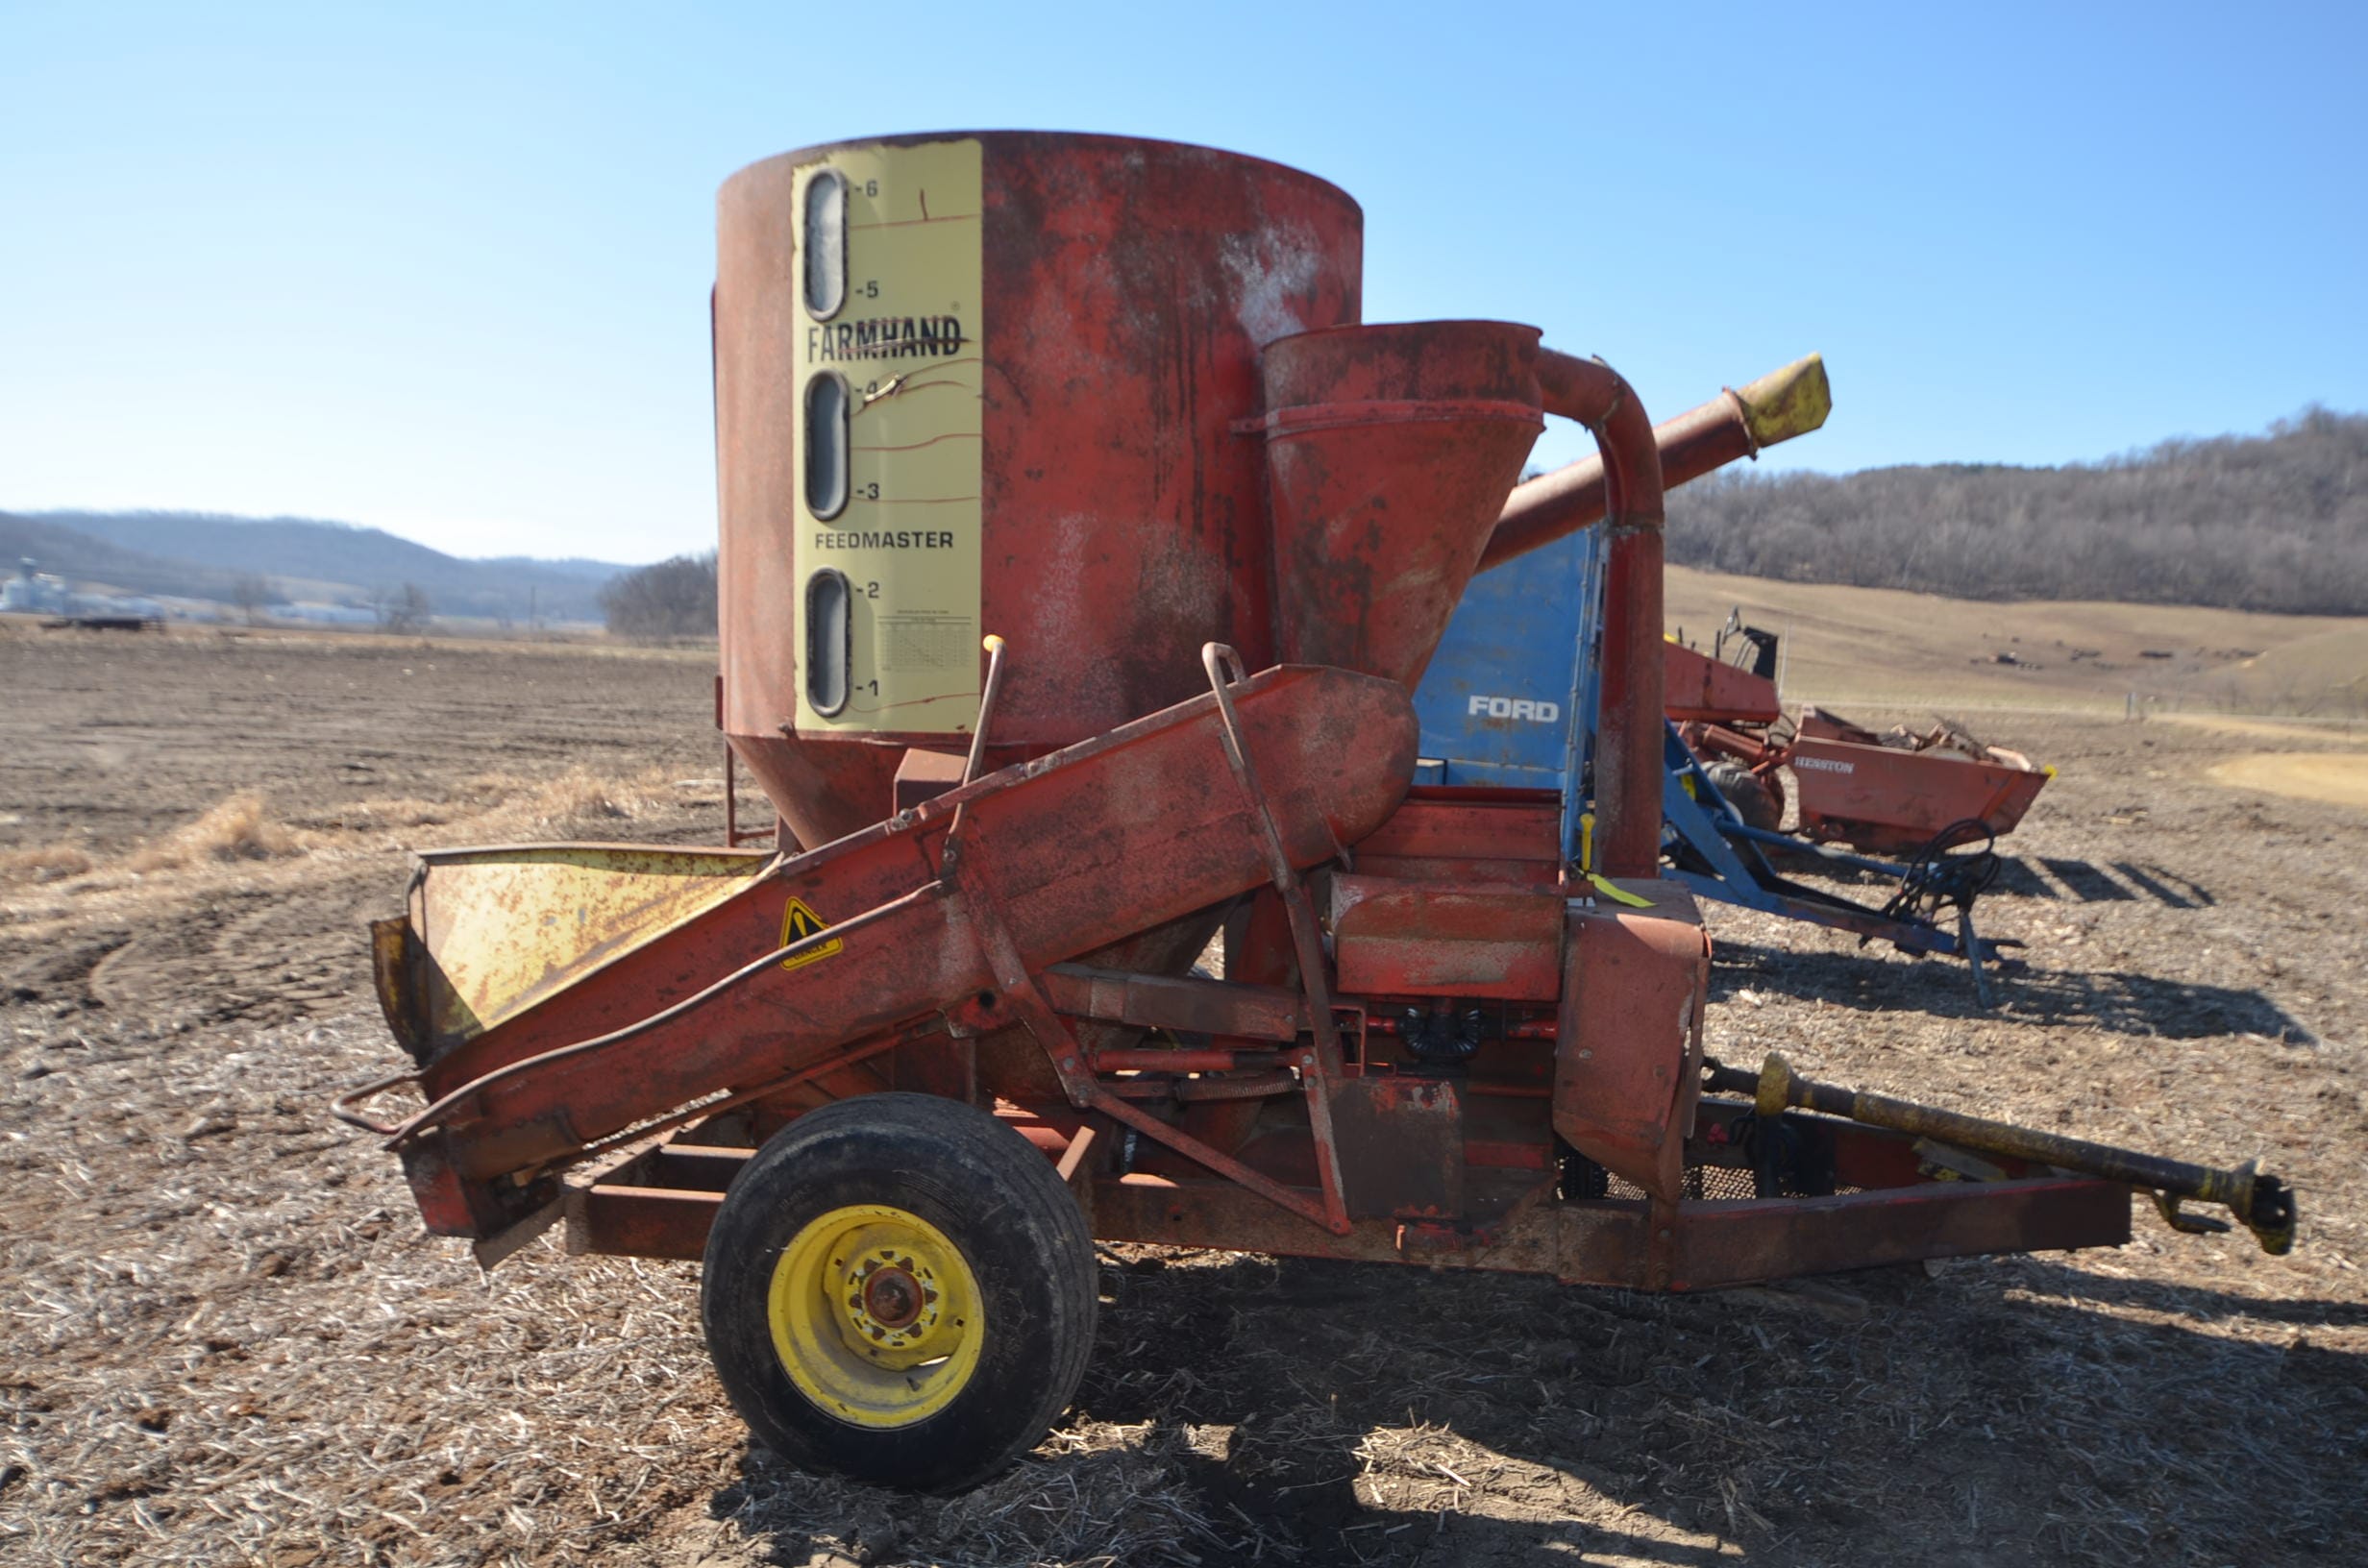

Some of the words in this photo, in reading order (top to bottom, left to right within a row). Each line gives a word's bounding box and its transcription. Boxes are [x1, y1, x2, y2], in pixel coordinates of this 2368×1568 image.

[807, 315, 961, 363] FARMHAND
[815, 530, 954, 549] FEEDMASTER
[1468, 695, 1559, 723] FORD
